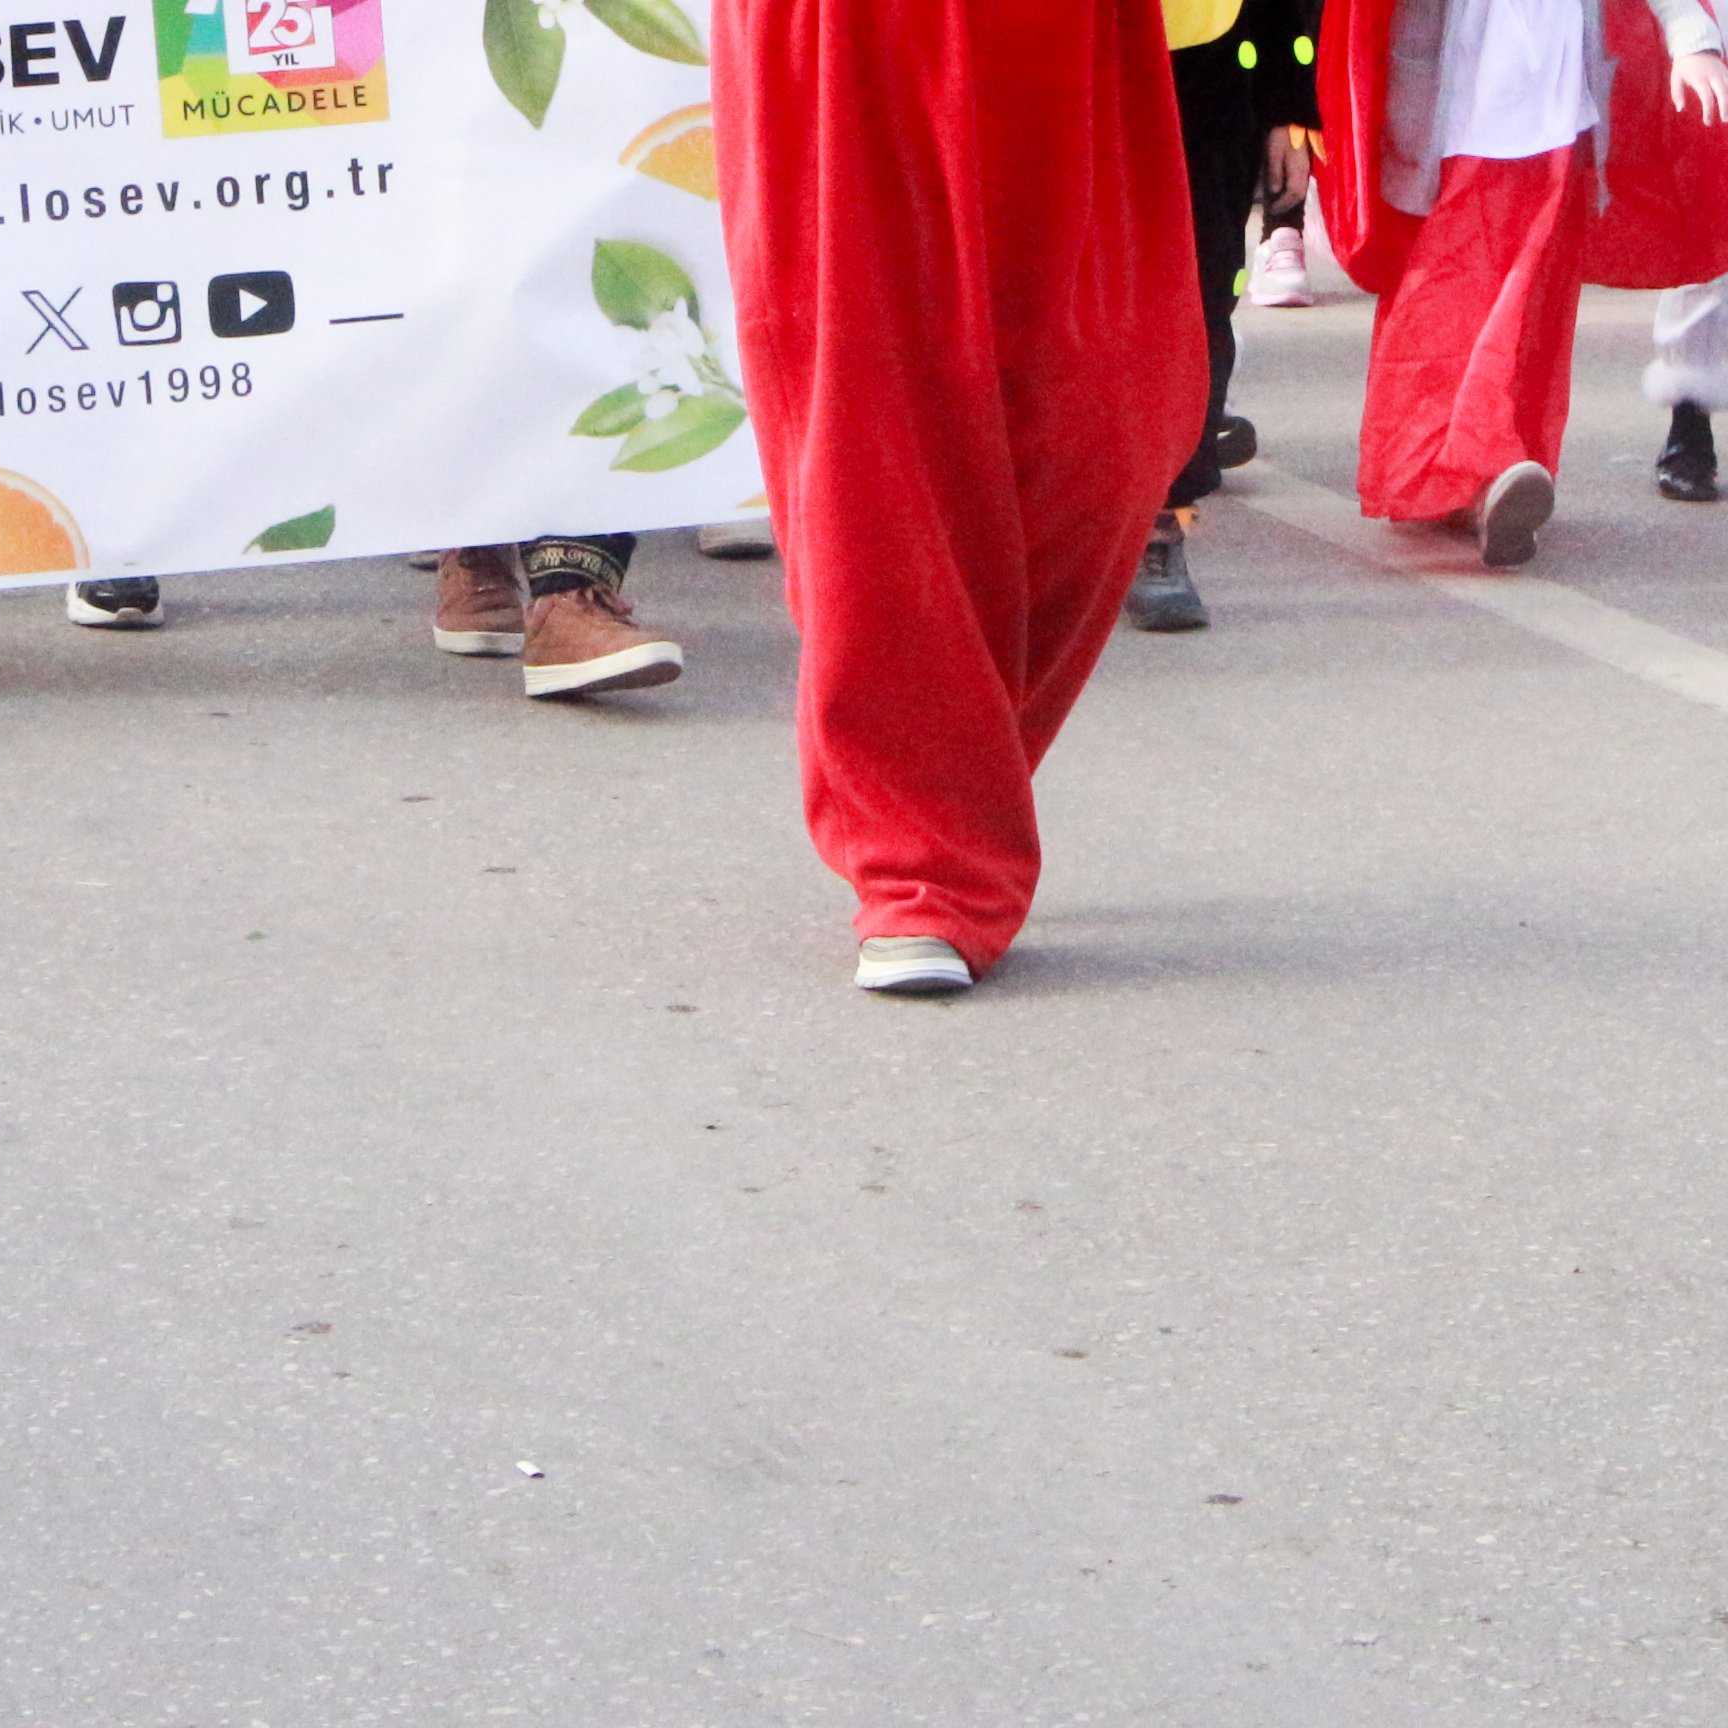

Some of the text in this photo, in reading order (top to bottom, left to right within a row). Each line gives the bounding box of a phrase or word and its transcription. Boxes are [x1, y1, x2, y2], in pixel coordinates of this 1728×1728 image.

[272, 52, 300, 67] YIL
[51, 103, 135, 132] UMUT
[182, 85, 368, 121] MÜCADELE
